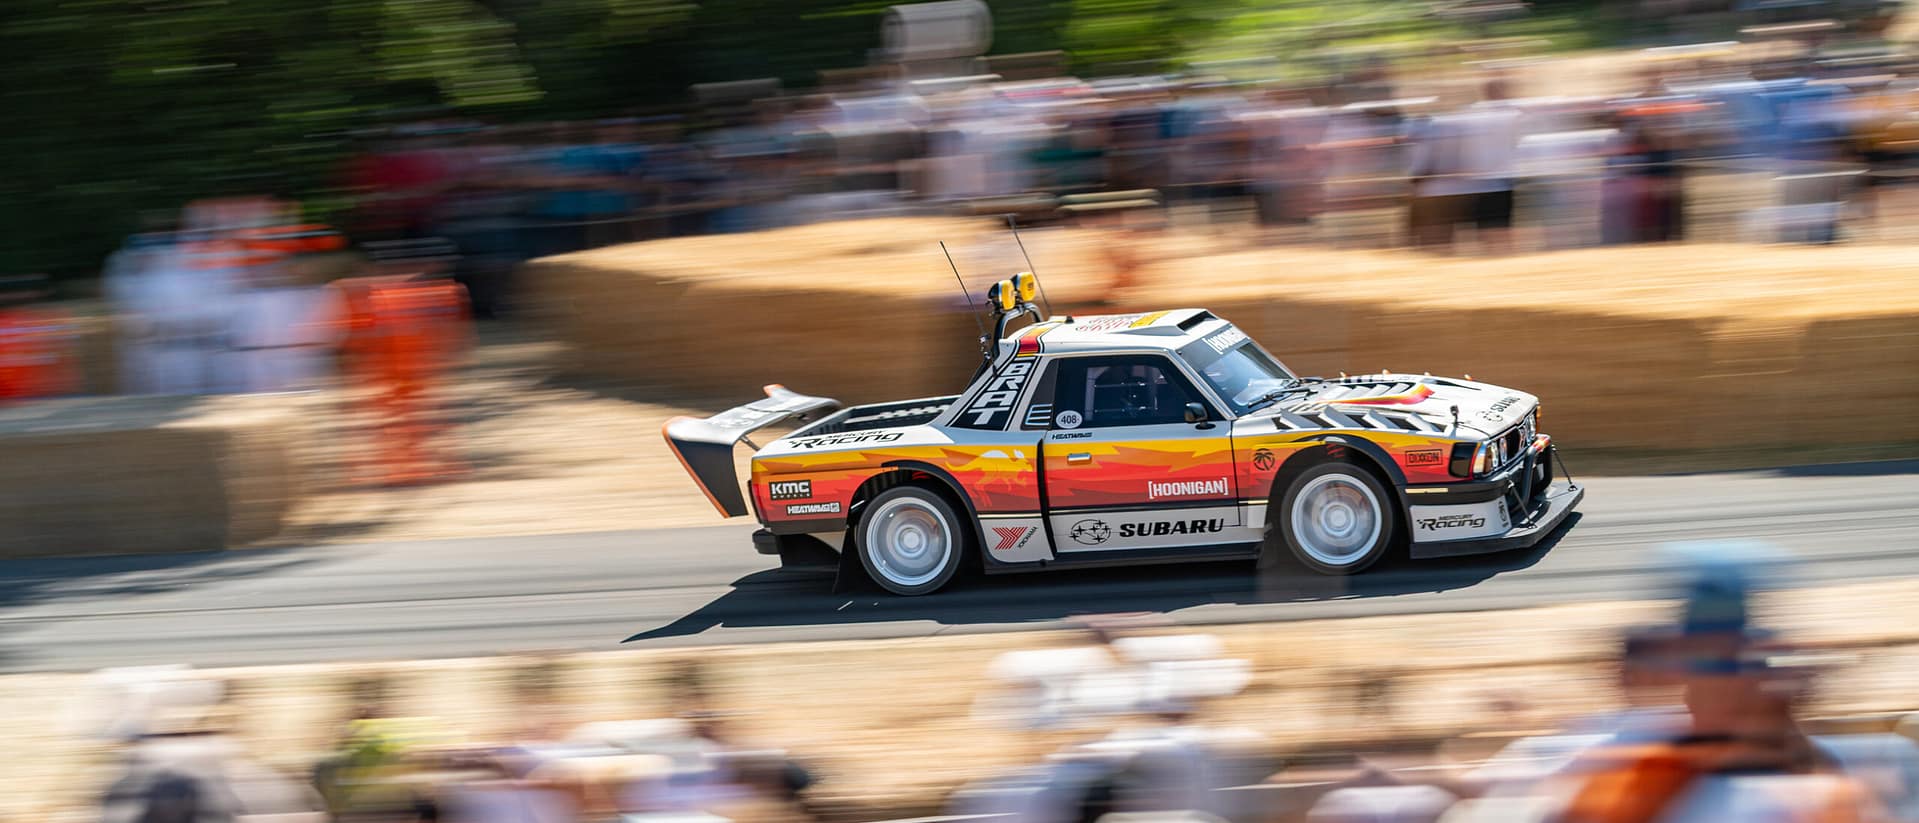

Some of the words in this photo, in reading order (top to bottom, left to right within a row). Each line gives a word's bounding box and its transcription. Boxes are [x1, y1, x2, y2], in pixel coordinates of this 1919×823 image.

[967, 362, 1032, 425] BRAT
[1061, 415, 1077, 425] 408
[791, 432, 904, 448] Racing
[771, 482, 810, 495] KMC
[1148, 477, 1228, 499] [HOONIGAN]
[1119, 518, 1224, 537] SUBARU
[1420, 517, 1485, 531] Racing
